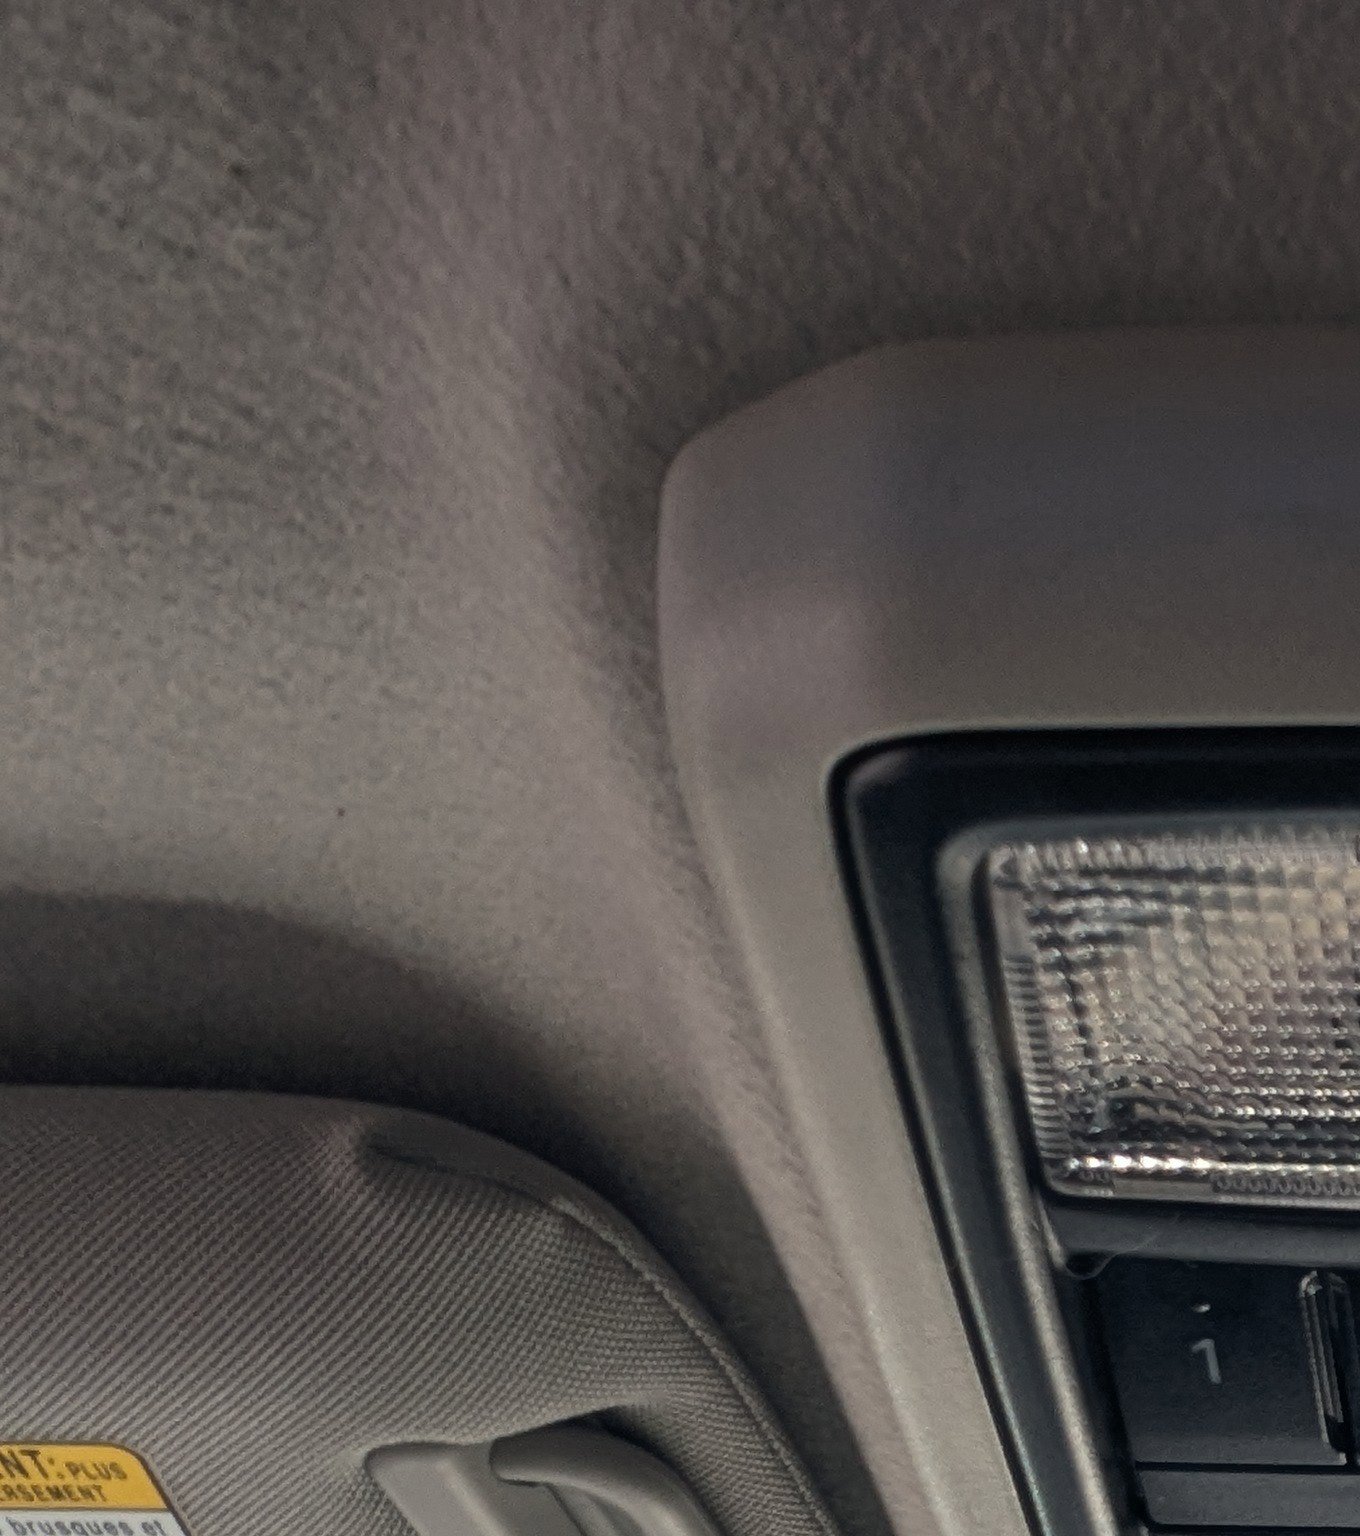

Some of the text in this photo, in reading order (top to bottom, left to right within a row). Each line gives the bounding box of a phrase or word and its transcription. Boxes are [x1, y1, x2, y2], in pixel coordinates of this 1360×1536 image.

[1191, 1338, 1221, 1385] 1
[0, 1449, 128, 1480] NT: PLUS
[0, 1484, 108, 1501] RSEMENT
[141, 1519, 167, 1536] et
